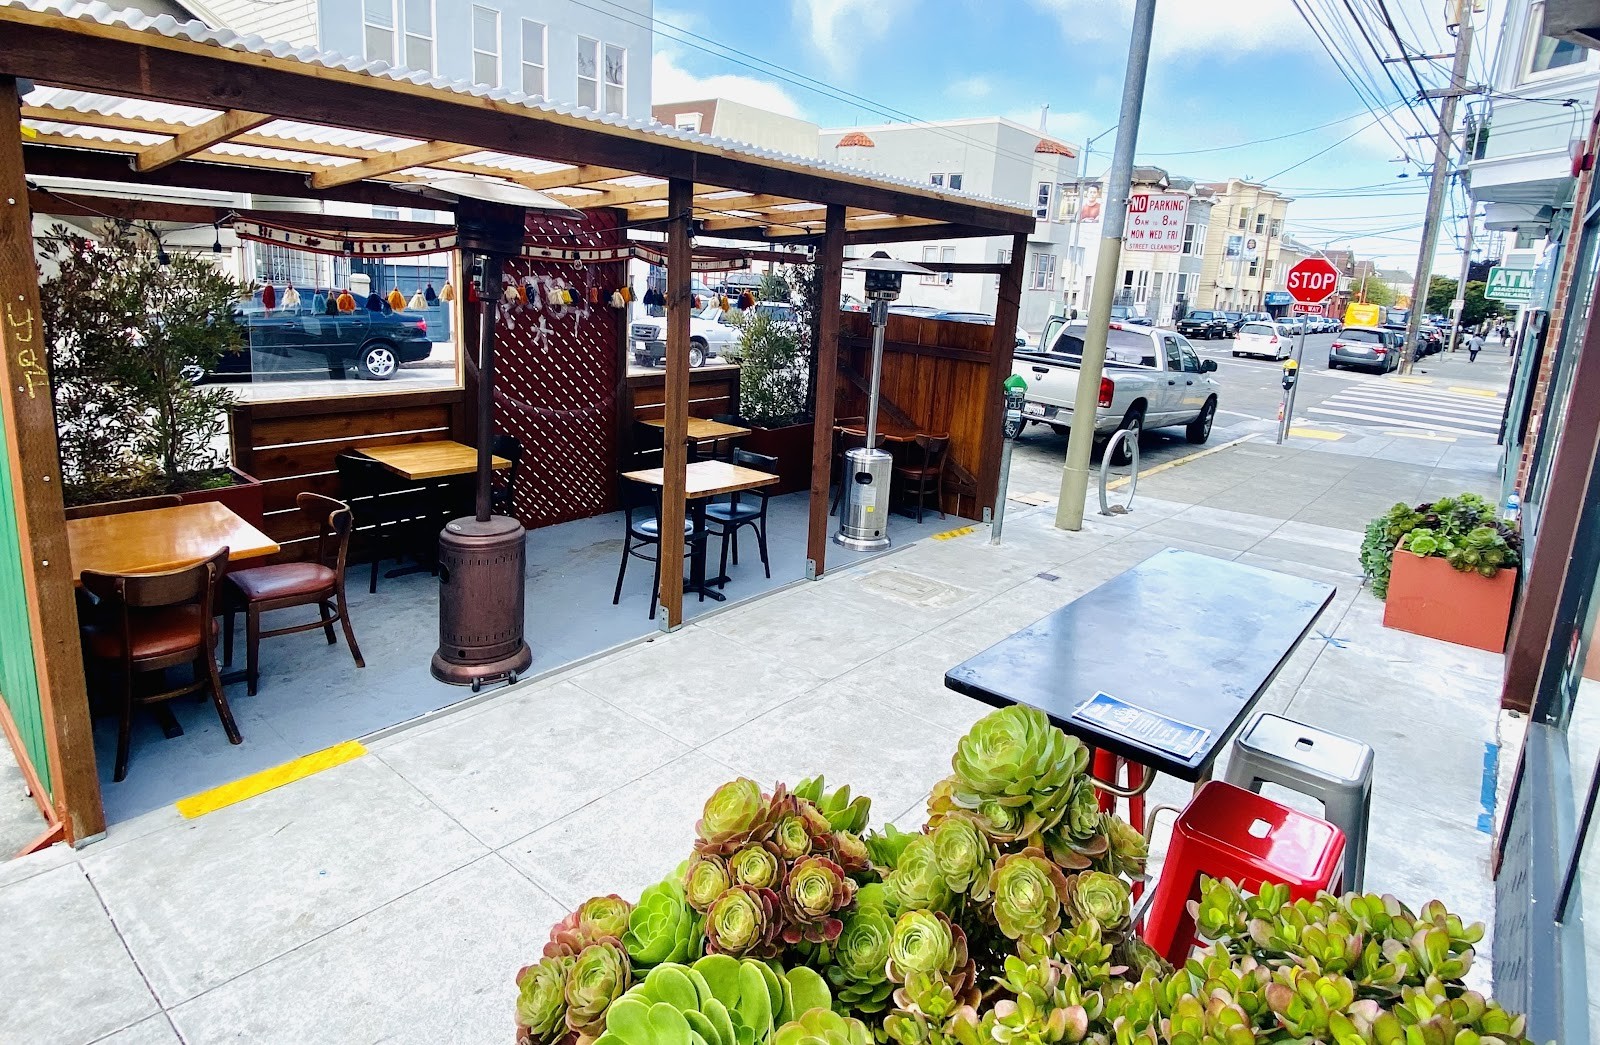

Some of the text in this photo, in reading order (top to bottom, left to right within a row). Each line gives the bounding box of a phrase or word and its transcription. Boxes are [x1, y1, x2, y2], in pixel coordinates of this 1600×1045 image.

[1131, 196, 1184, 211] NO PARKING
[1135, 215, 1149, 225] 6AM
[1162, 215, 1178, 226] 8AM
[1130, 230, 1178, 240] MON WED FRI
[1289, 272, 1335, 290] STOP
[1490, 270, 1534, 288] ATM
